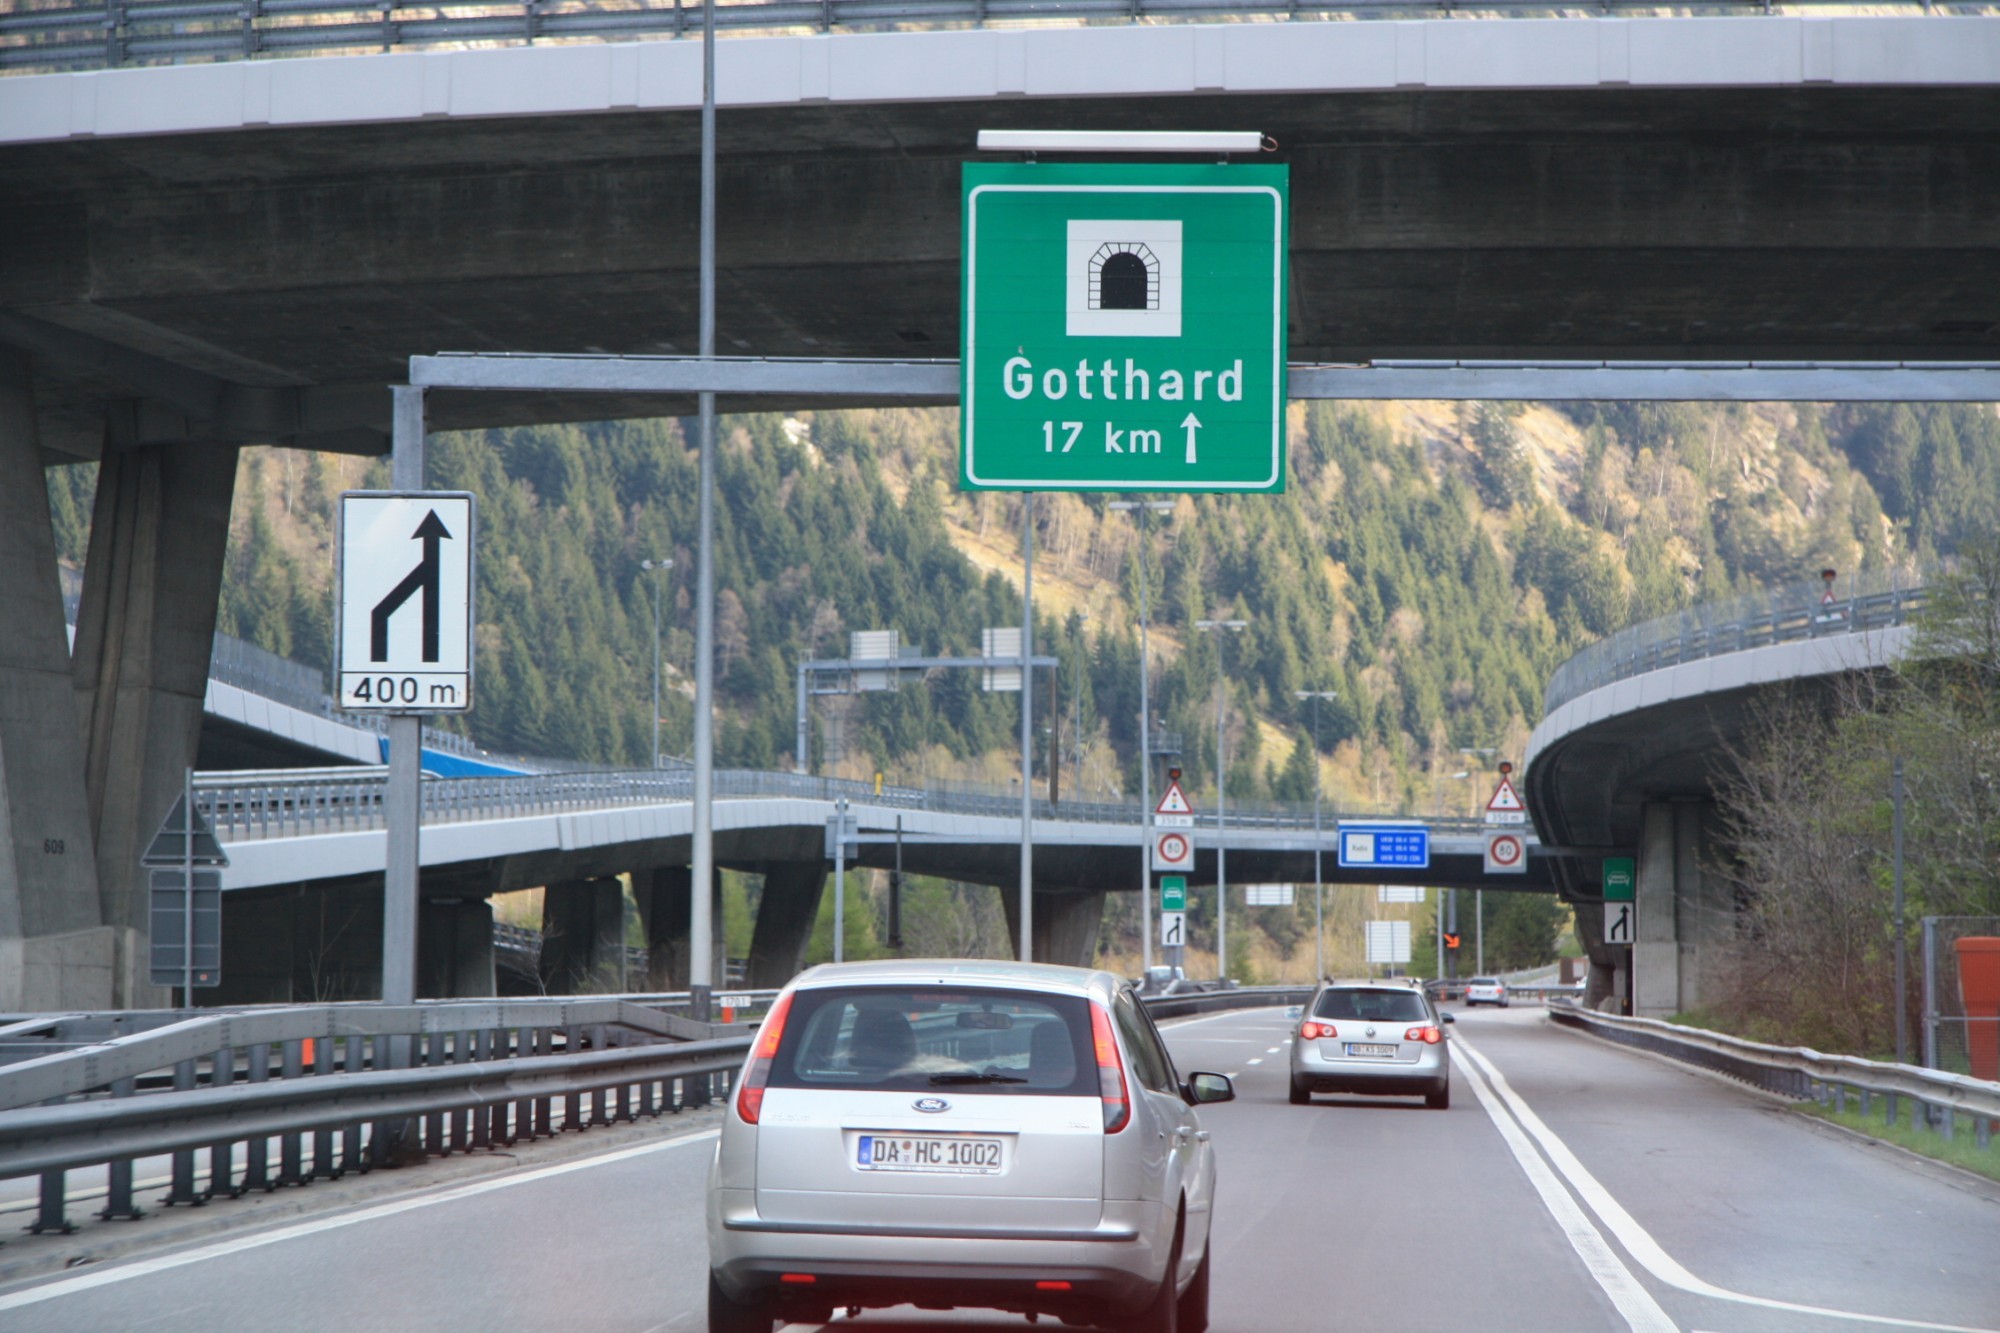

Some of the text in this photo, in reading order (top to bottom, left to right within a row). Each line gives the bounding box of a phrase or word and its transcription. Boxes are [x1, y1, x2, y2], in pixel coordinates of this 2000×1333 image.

[1003, 357, 1243, 402] Gotthard
[1042, 421, 1162, 454] 17 km
[353, 677, 455, 703] 400 m
[1491, 814, 1508, 822] 350
[43, 838, 65, 855] 609
[1167, 842, 1180, 854] 80
[1499, 845, 1513, 857] 80
[873, 1140, 999, 1166] DA HC 1002
